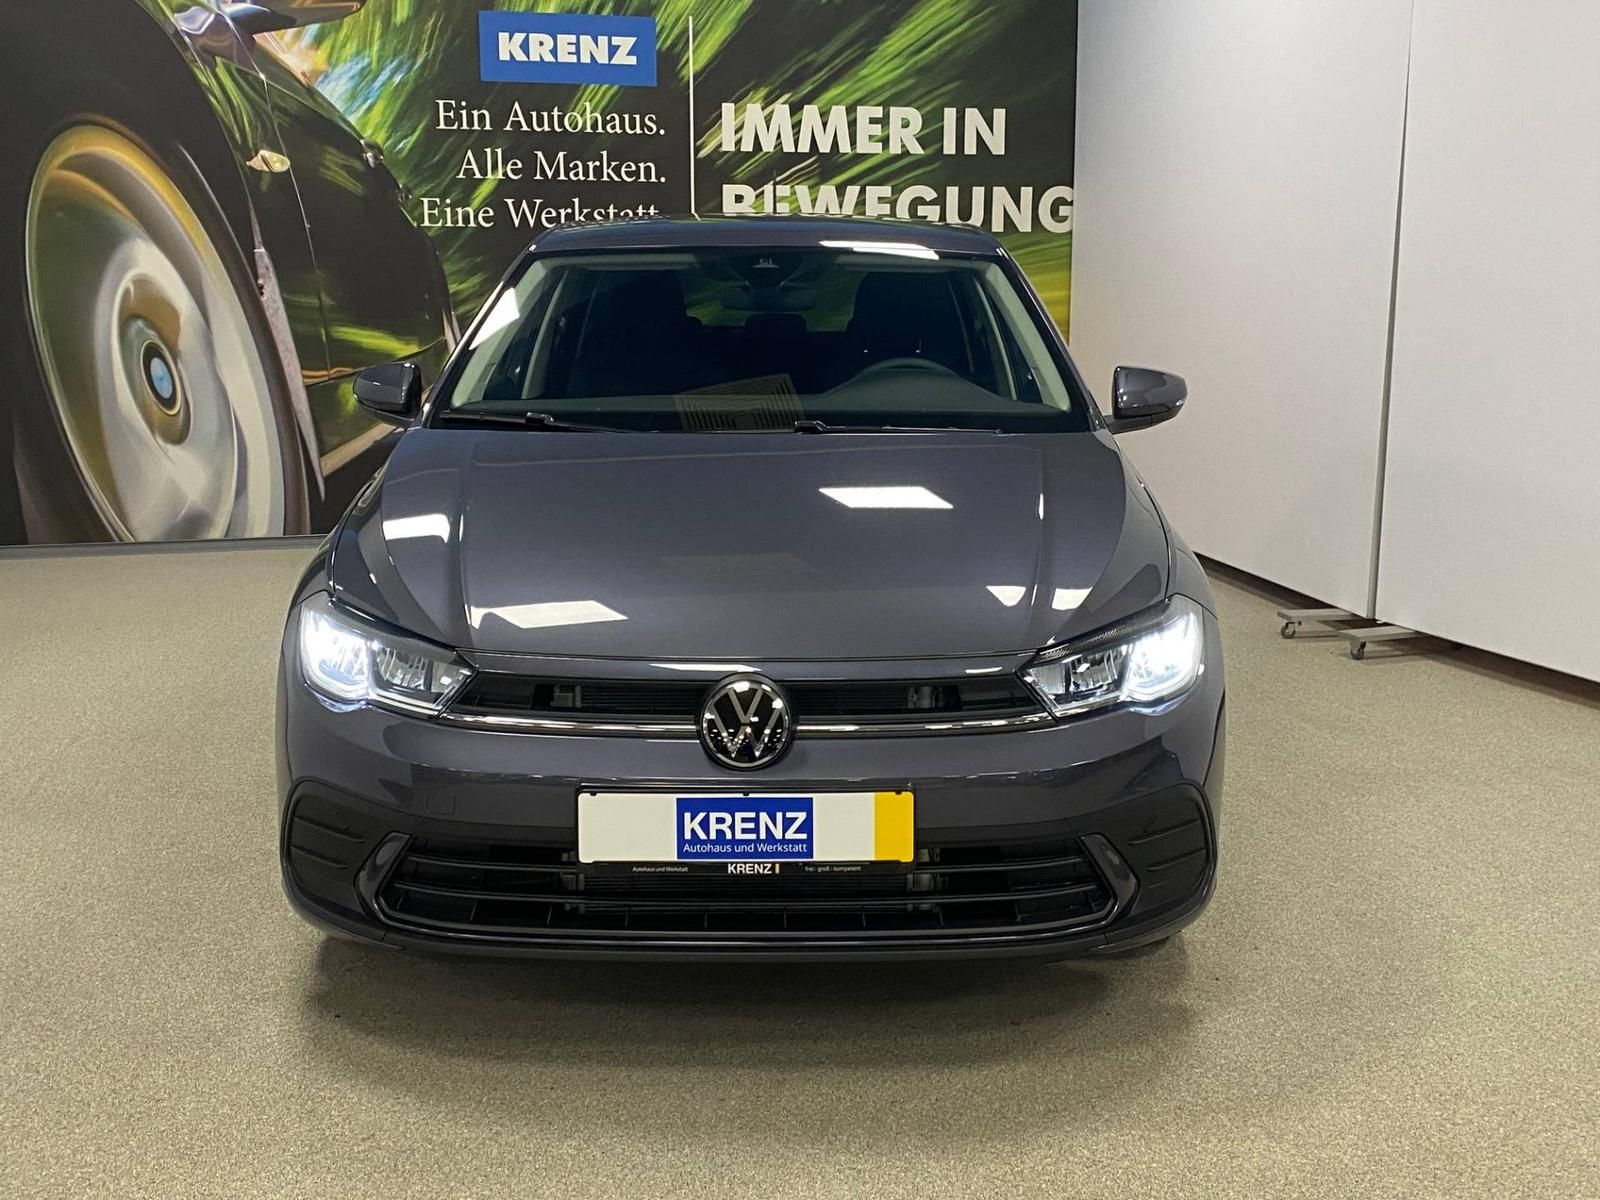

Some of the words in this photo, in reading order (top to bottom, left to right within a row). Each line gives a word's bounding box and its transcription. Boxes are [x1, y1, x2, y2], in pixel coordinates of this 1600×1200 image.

[497, 31, 638, 66] KRENZ
[434, 99, 494, 131] Ein
[503, 100, 667, 136] Autohaus.
[721, 102, 925, 155] IMMER
[942, 107, 1007, 156] IN
[455, 147, 524, 180] Alle
[533, 150, 667, 184] Marken.
[419, 196, 496, 229] Eine
[683, 811, 808, 840] KRENZ
[682, 842, 732, 854] Autohaus
[734, 842, 755, 854] und
[756, 842, 808, 854] Werkstatt
[727, 863, 772, 874] KRENZ
